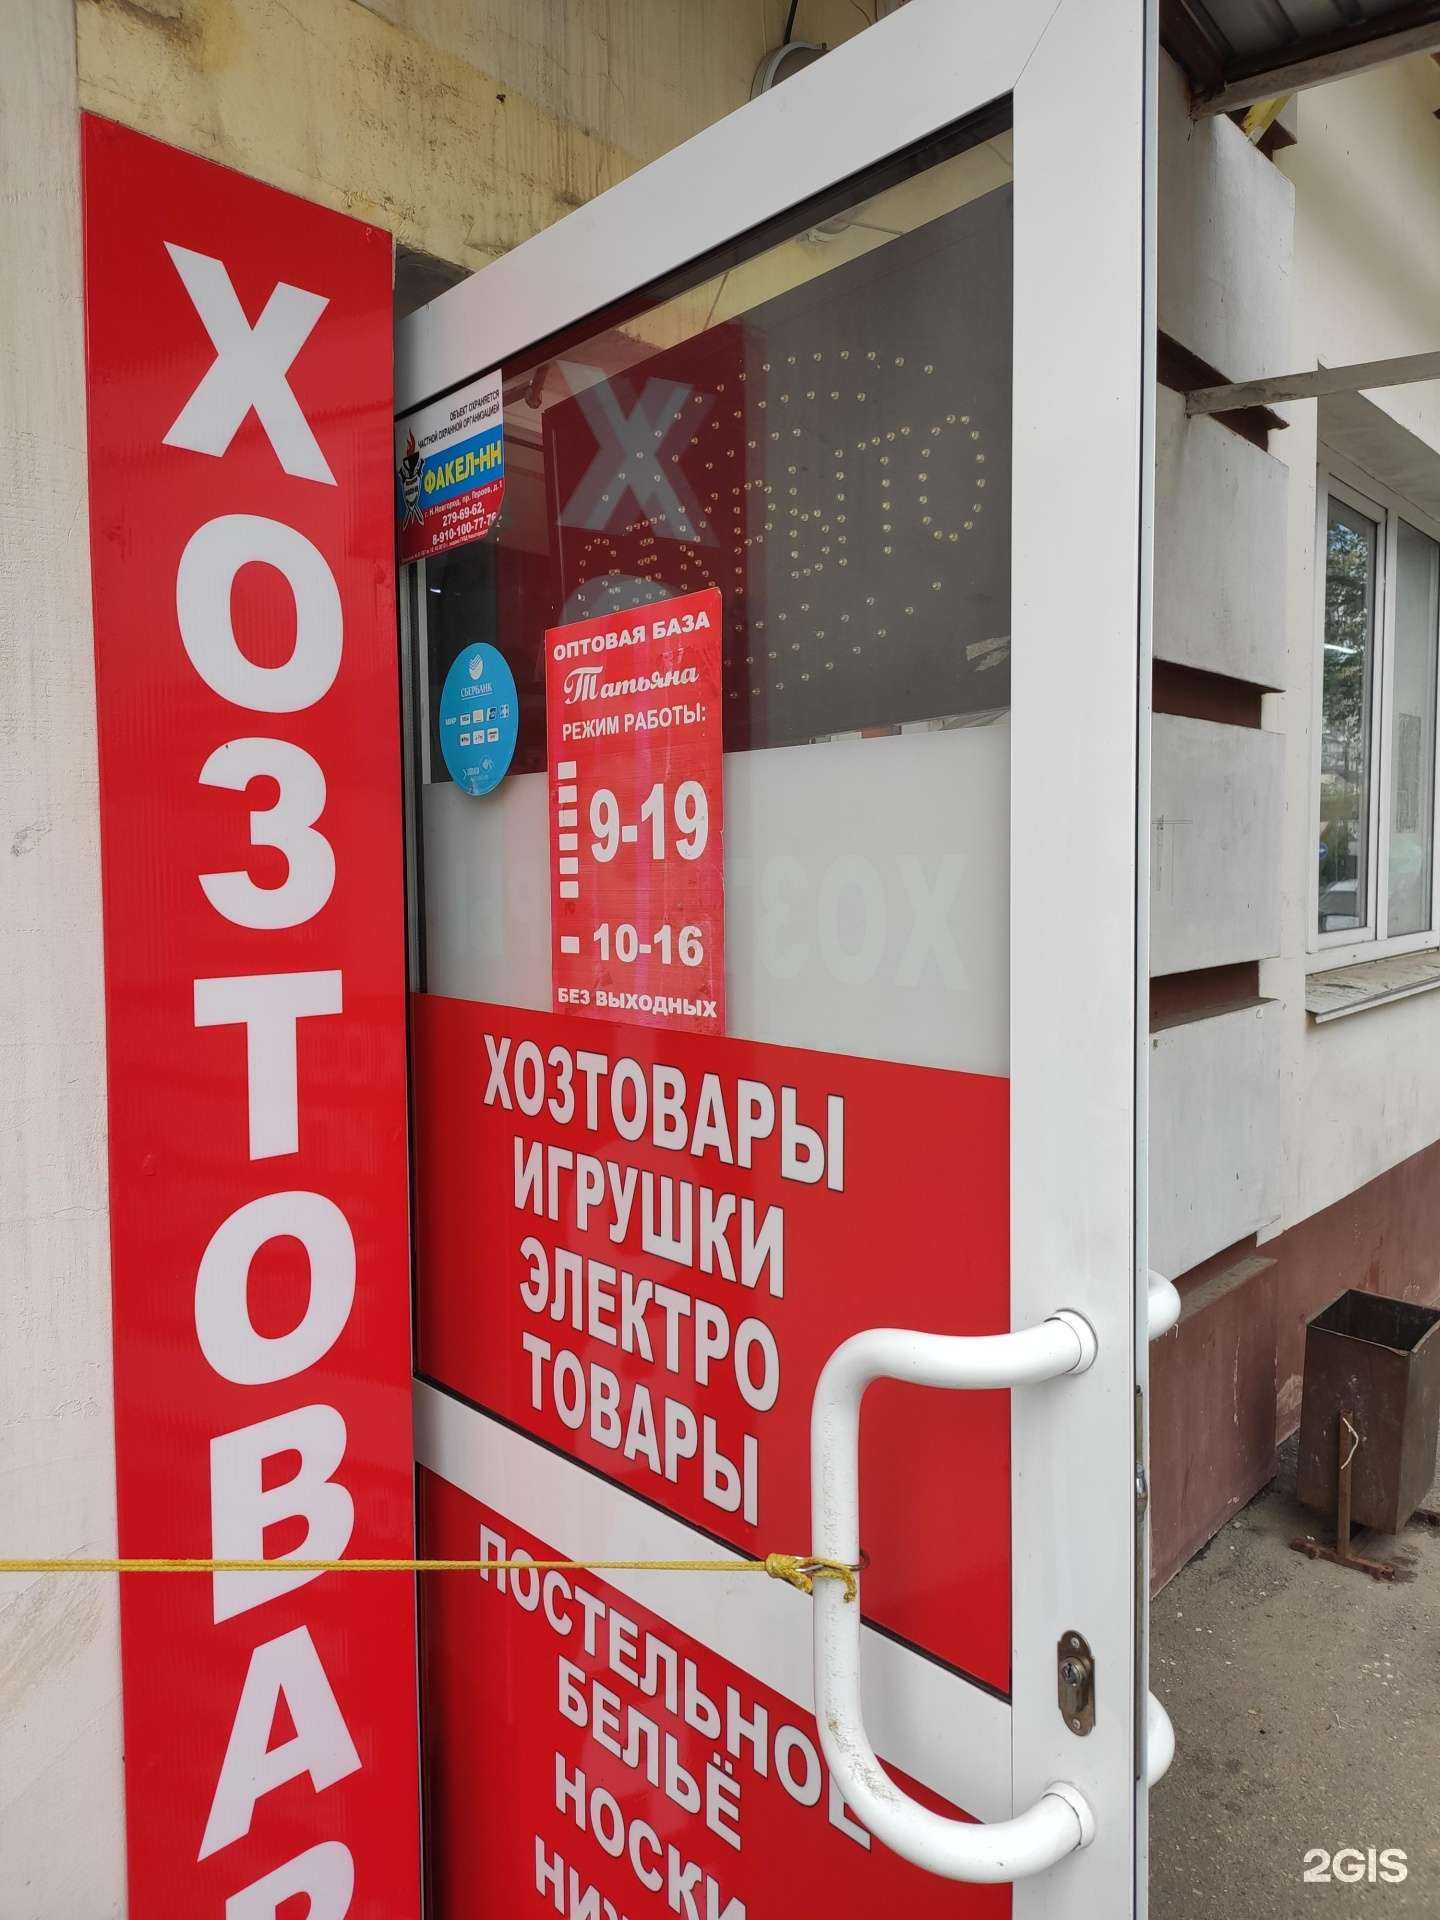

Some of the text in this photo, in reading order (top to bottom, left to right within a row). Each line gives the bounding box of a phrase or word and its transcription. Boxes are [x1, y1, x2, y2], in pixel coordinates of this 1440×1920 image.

[417, 401, 500, 449] ЧАСТНОЙ ОХРАННОЙ ОРГАНИЗАЦИЕЙ
[449, 389, 500, 421] ОБЪЕКТ ОХРАНЯЕТСЯ
[423, 440, 502, 495] ФАКЕЛ-НН
[553, 610, 711, 661] ОПТОВАЯ БАЗА
[460, 682, 493, 698] СБЕРБАНК
[563, 664, 700, 705] Татьяна
[562, 702, 707, 742] РЕЖИМ РАБОТЫ:
[589, 780, 710, 863] 9-19
[593, 922, 704, 967] 10-16
[557, 987, 718, 1018] БЕЗ ВЫХОДНЫХ
[482, 1032, 846, 1193] ХОЗТОВАРЫ
[513, 1135, 786, 1299] ИГРУШКИ
[518, 1236, 782, 1413] ЭЛЕКТРО
[521, 1331, 760, 1528] ТОВАРЫ
[557, 1653, 742, 1852] БЕЛЬЁ
